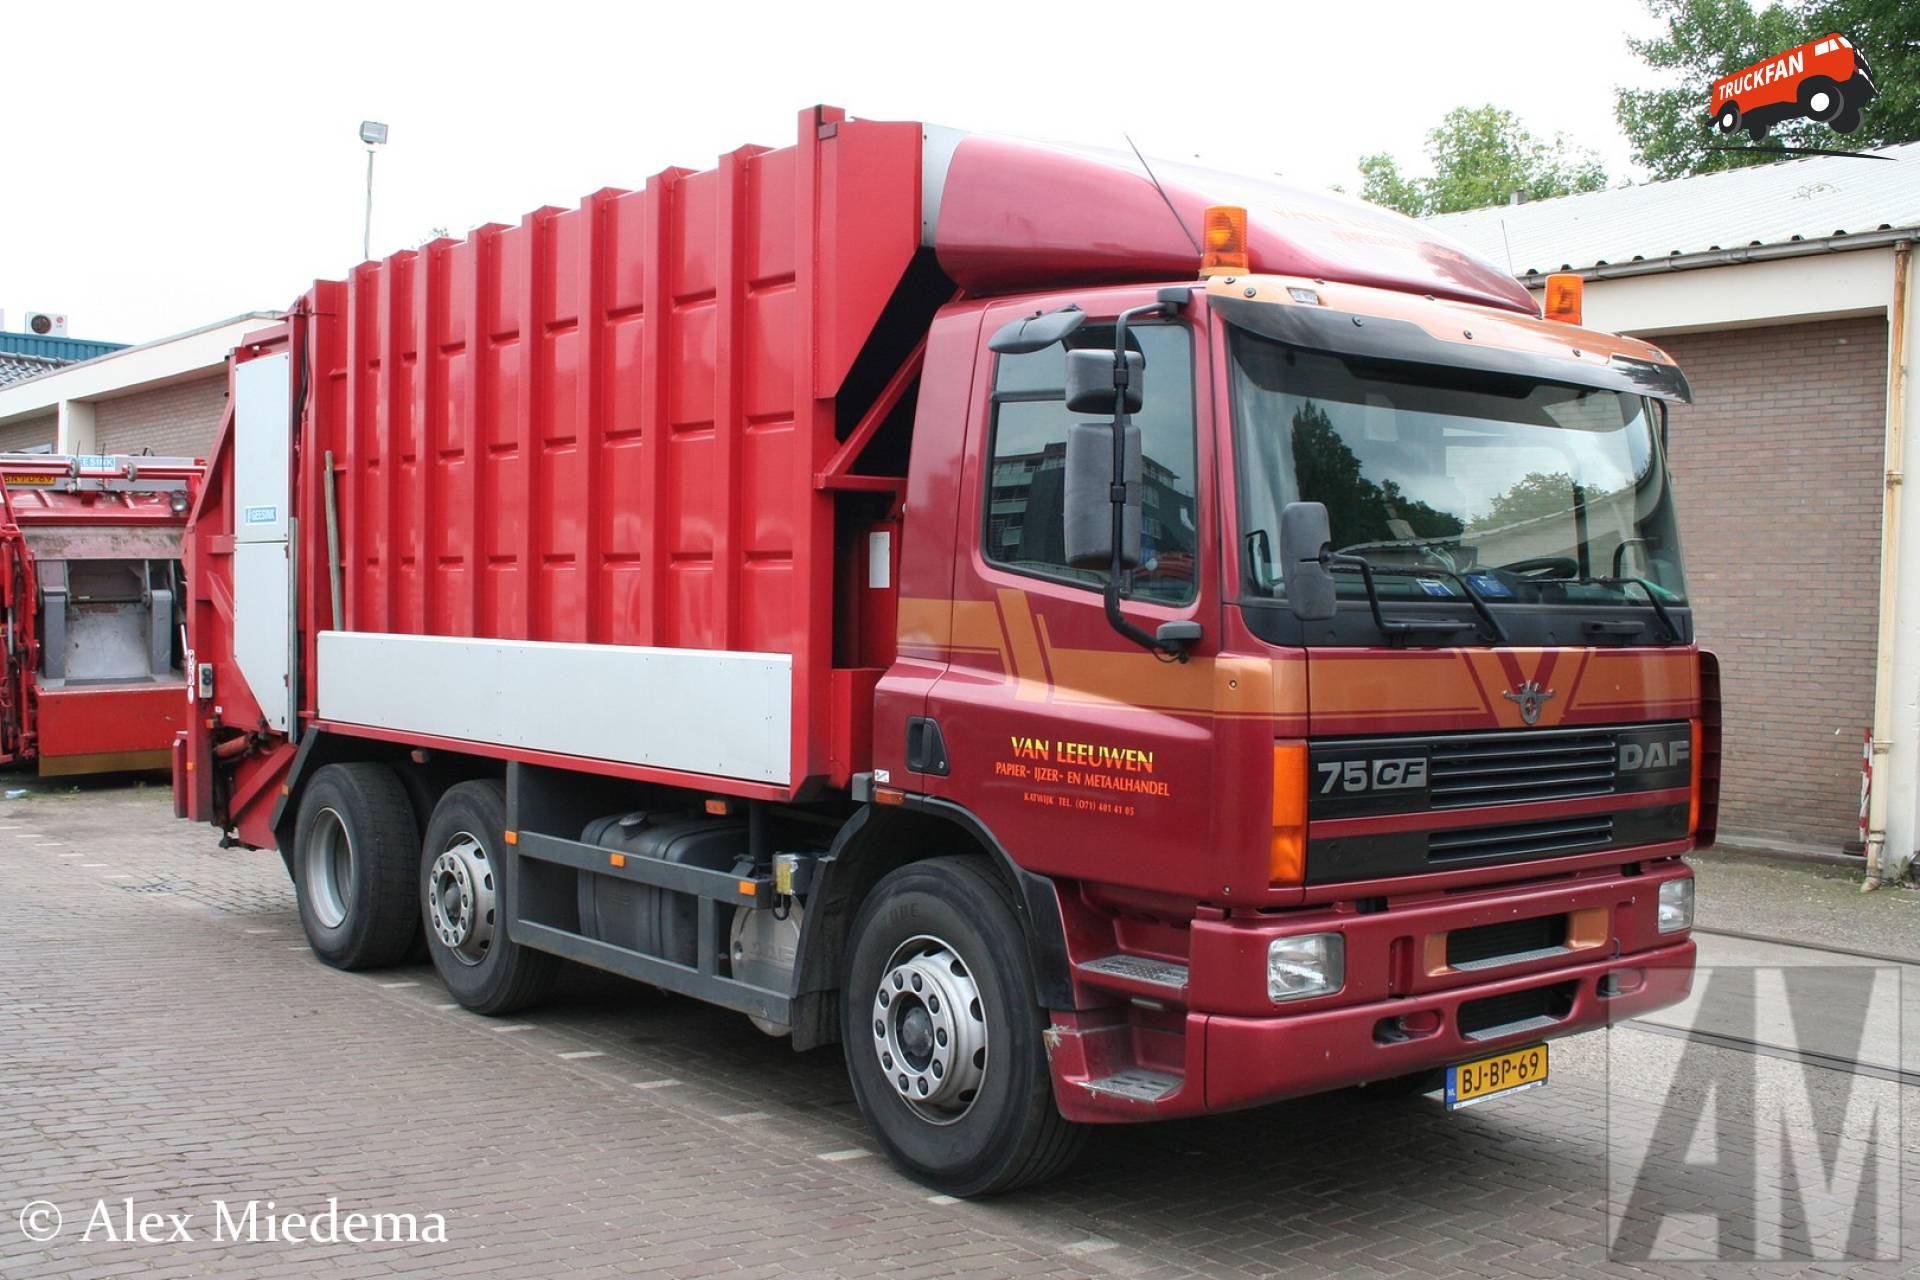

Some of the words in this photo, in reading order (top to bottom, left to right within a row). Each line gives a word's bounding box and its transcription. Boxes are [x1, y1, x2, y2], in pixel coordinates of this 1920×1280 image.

[1010, 736, 1049, 761] VAN
[1056, 741, 1153, 773] LEEUWEN
[1618, 740, 1689, 771] DAF
[995, 761, 1031, 779] PAPIER-
[1034, 767, 1063, 783] IJZER-
[1067, 771, 1081, 786] EN
[1083, 773, 1170, 797] METAALHANDEL
[1023, 791, 1054, 806] KATWIJK
[1058, 796, 1072, 809] TEL.
[1075, 798, 1096, 811] (071)
[1462, 1052, 1539, 1094] BJ-BP-69
